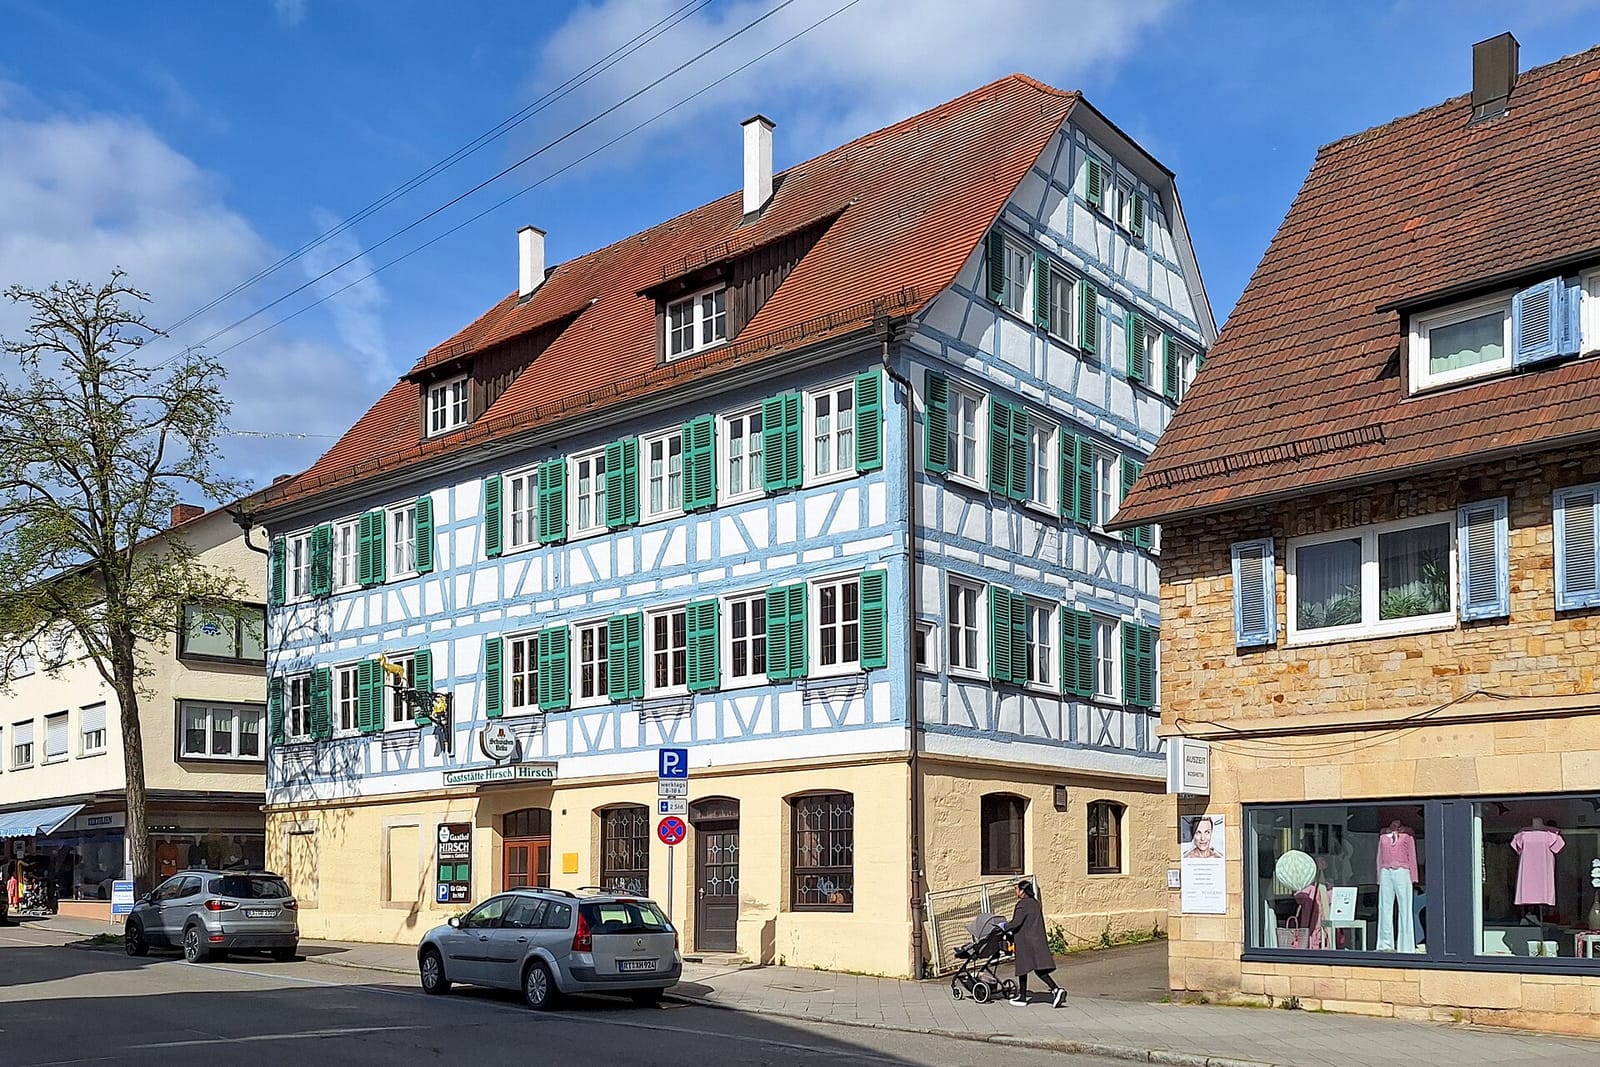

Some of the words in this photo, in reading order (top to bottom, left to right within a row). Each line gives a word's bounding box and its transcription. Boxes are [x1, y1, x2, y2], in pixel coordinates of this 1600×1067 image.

[663, 751, 680, 775] P
[1186, 755, 1206, 765] AUSZEIT
[446, 770, 485, 784] Gaststätte
[485, 768, 513, 780] Hirsch
[519, 767, 553, 778] Hirsch
[450, 833, 470, 841] Gasthof
[440, 842, 470, 854] HIRSCH
[440, 886, 447, 899] P
